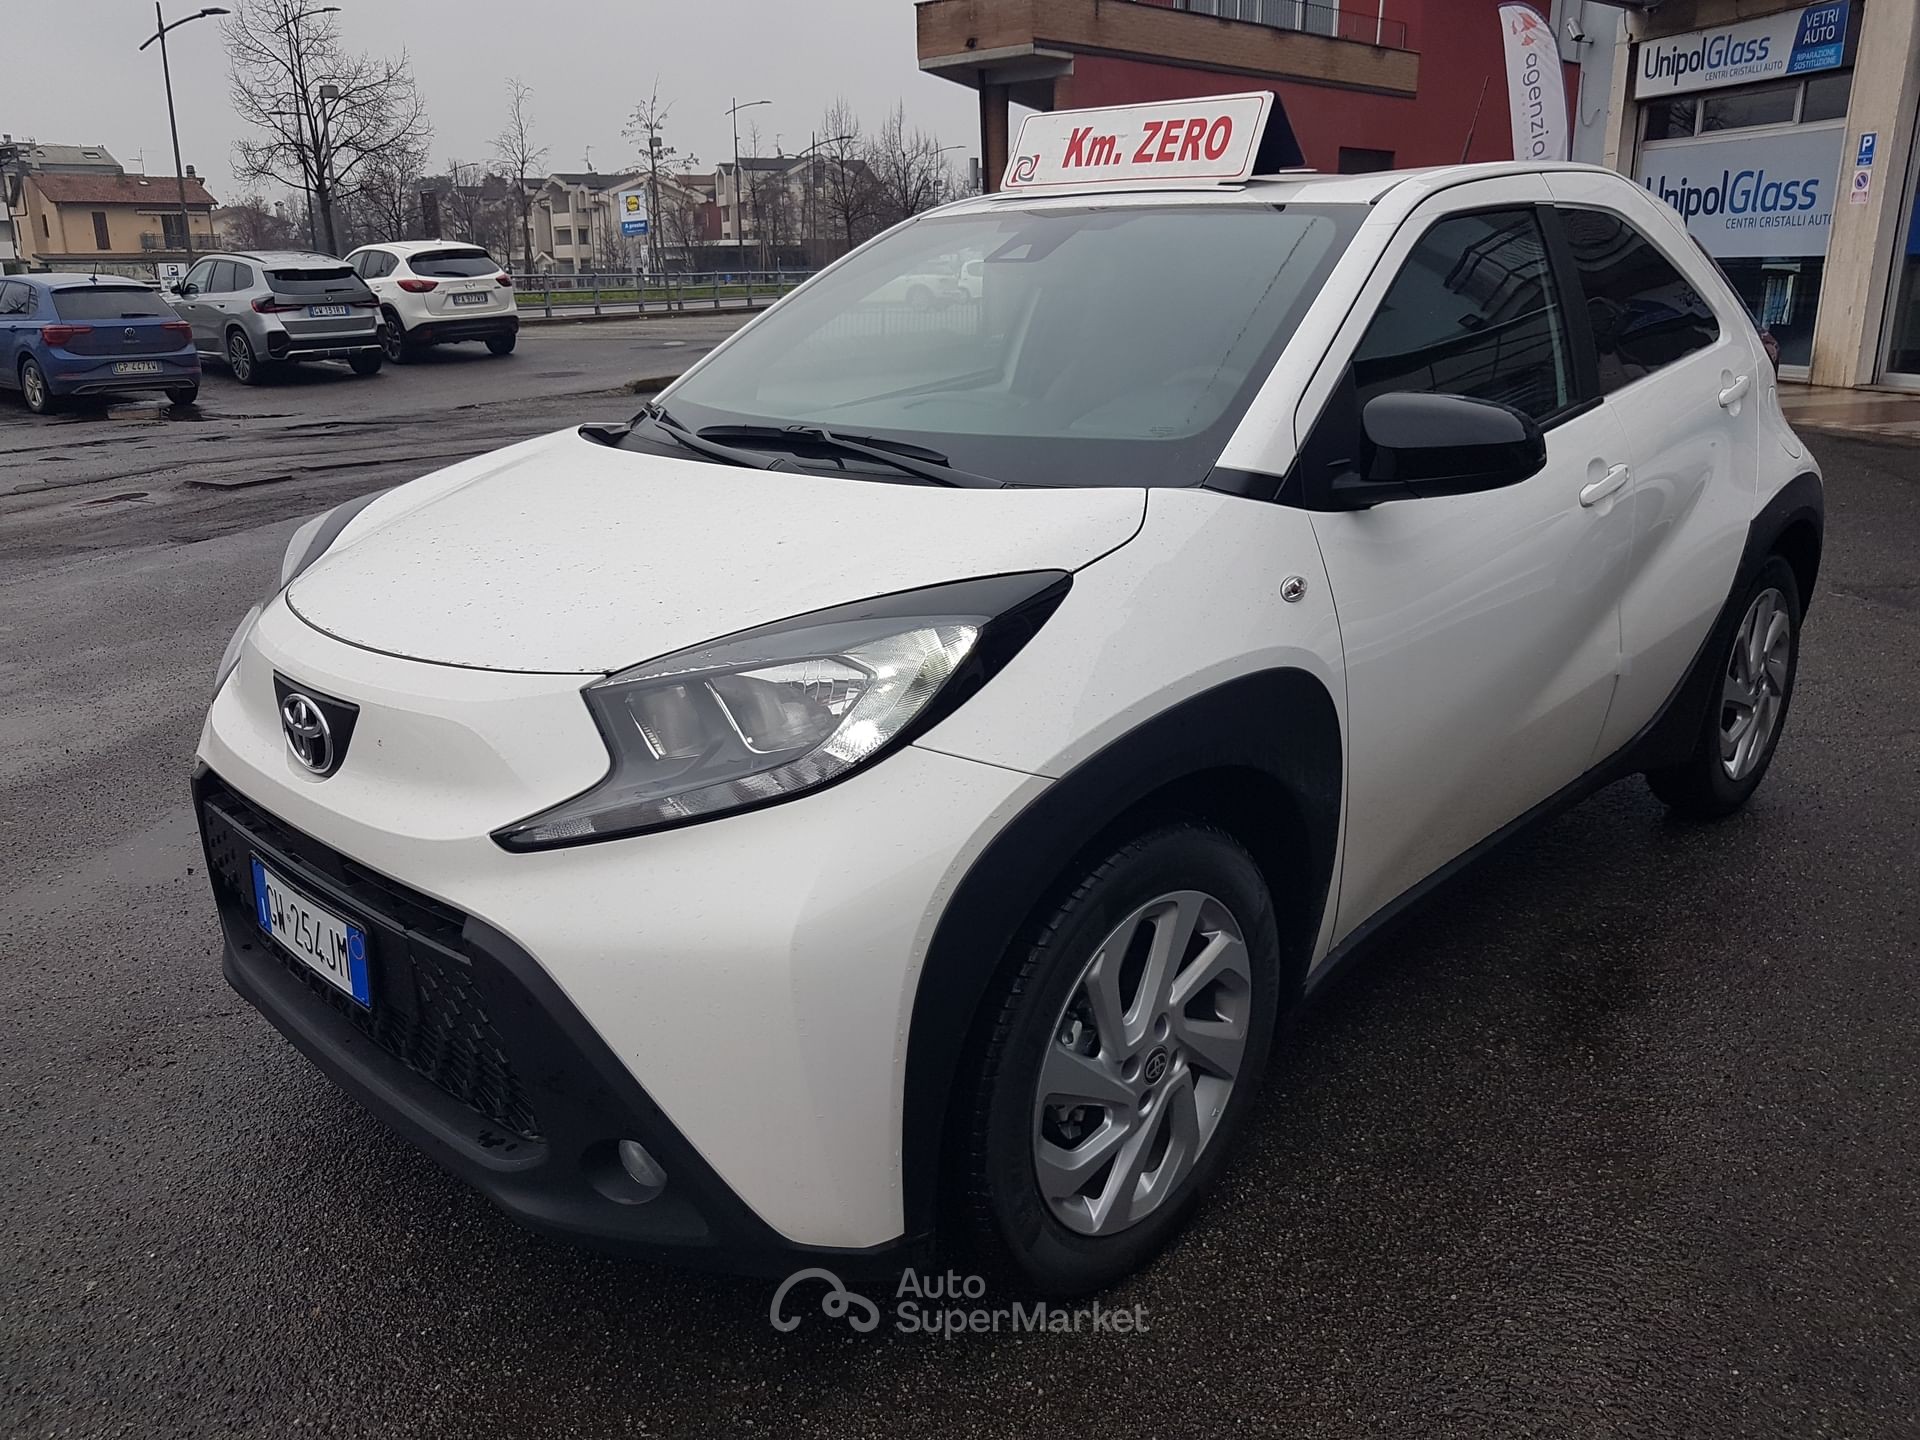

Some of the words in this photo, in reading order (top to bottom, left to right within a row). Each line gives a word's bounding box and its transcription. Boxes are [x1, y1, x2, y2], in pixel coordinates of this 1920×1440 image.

[1806, 8, 1839, 28] VETRI
[1803, 25, 1835, 45] AUTO
[1644, 34, 1770, 86] UnipolGlass
[1793, 56, 1837, 71] SOSTITUZIONE
[1796, 49, 1836, 61] RIPARAZIONE
[1704, 68, 1728, 81] CENTRI
[1729, 64, 1763, 77] CRISTALLI
[1763, 60, 1783, 71] AUTO
[1062, 126, 1122, 169] Km.
[1132, 115, 1233, 164] ZERO
[1861, 135, 1873, 152] P
[1725, 217, 1757, 230] CENTRI
[1759, 214, 1806, 228] CRISTALLI
[290, 903, 351, 981] 254JM
